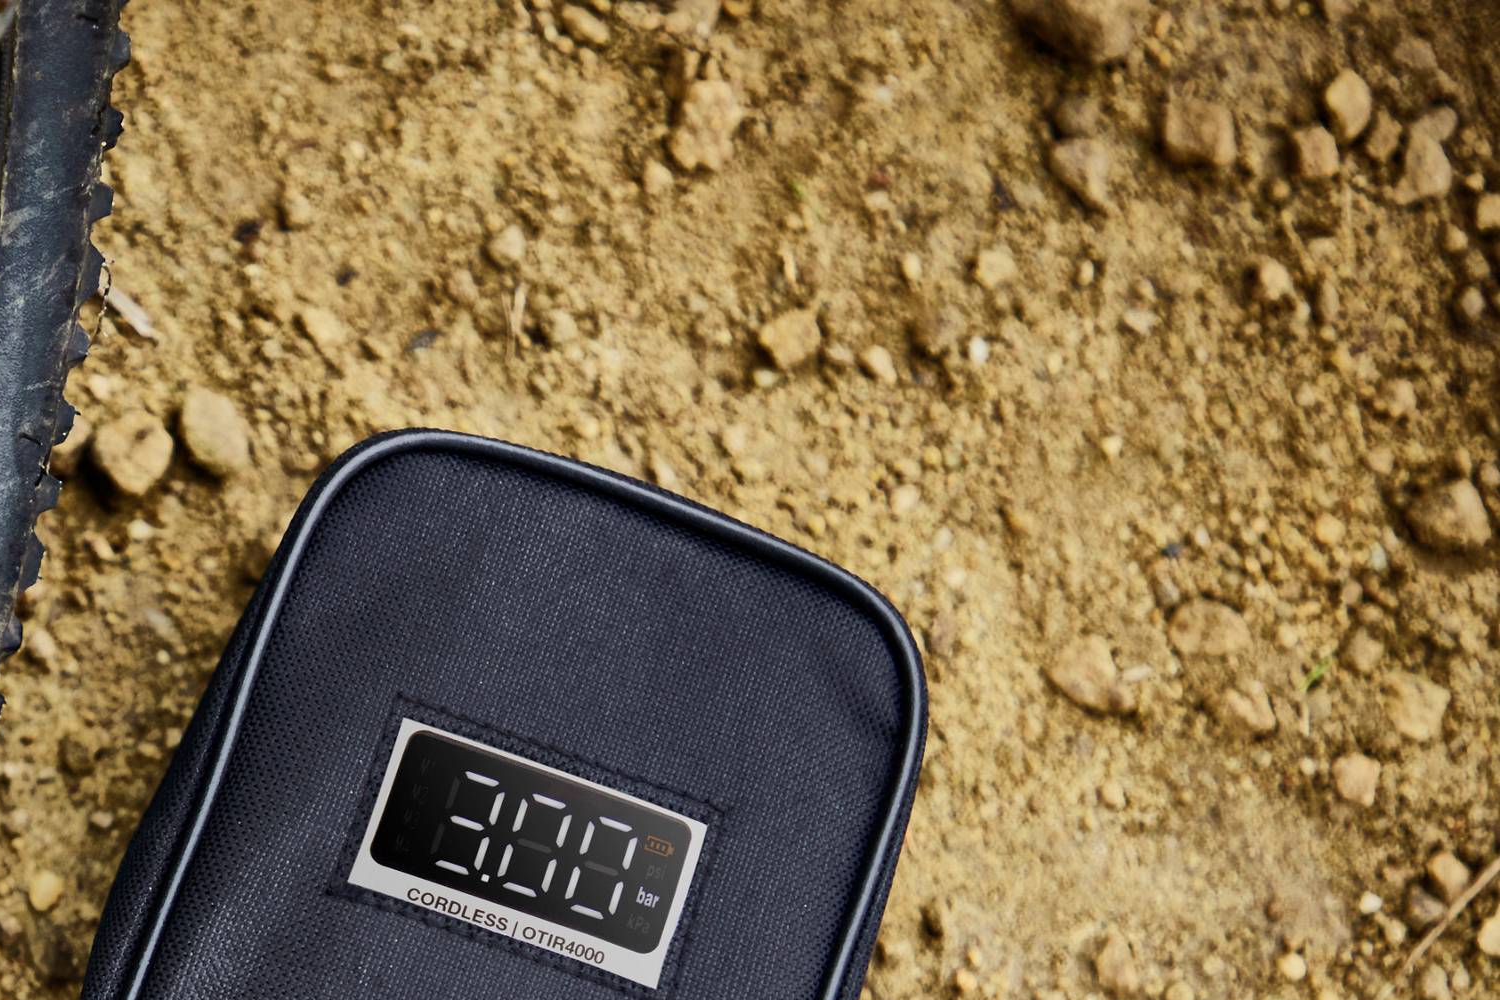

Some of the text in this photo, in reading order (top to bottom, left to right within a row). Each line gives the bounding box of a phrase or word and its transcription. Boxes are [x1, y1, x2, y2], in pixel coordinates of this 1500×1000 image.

[435, 771, 638, 919] 3.00
[406, 887, 508, 931] CORDLESS
[522, 925, 605, 964] OTIR4000
[636, 885, 660, 909] bar
